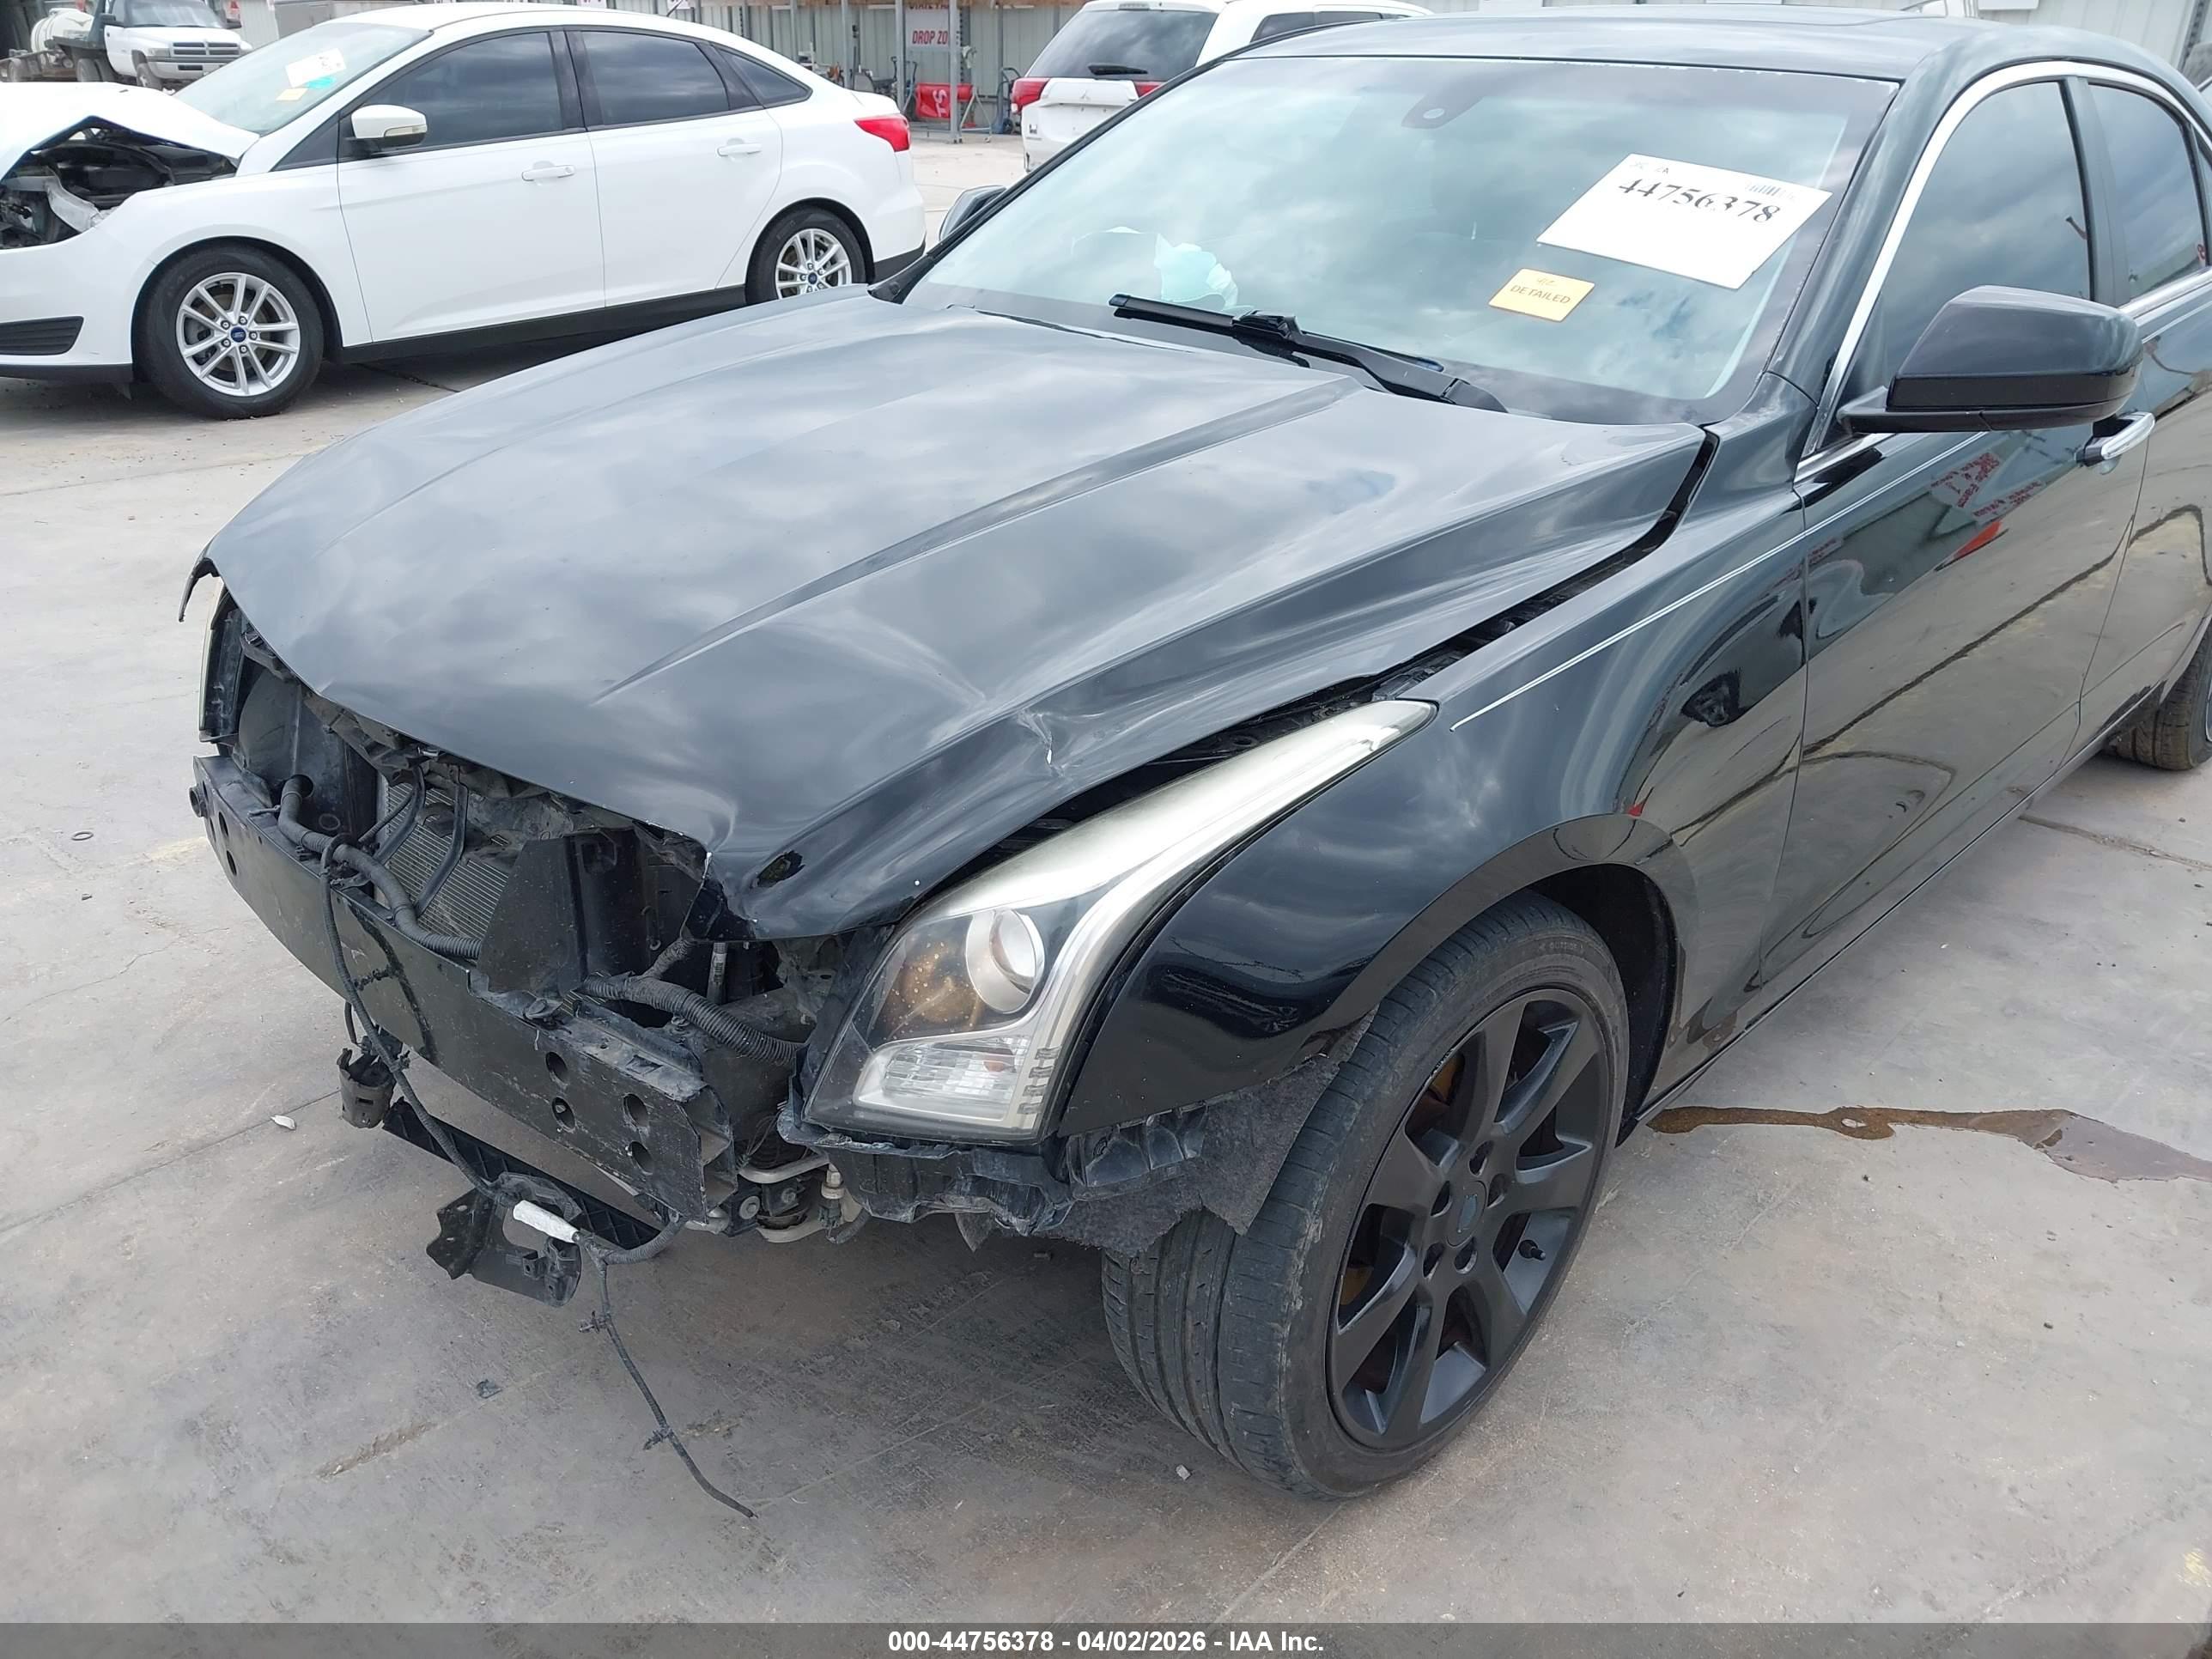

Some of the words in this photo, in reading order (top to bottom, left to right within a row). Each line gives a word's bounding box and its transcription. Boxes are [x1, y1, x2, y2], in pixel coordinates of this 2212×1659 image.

[912, 30, 936, 45] DROP
[1618, 178, 1781, 223] 44756378
[1510, 284, 1571, 304] DETAILED
